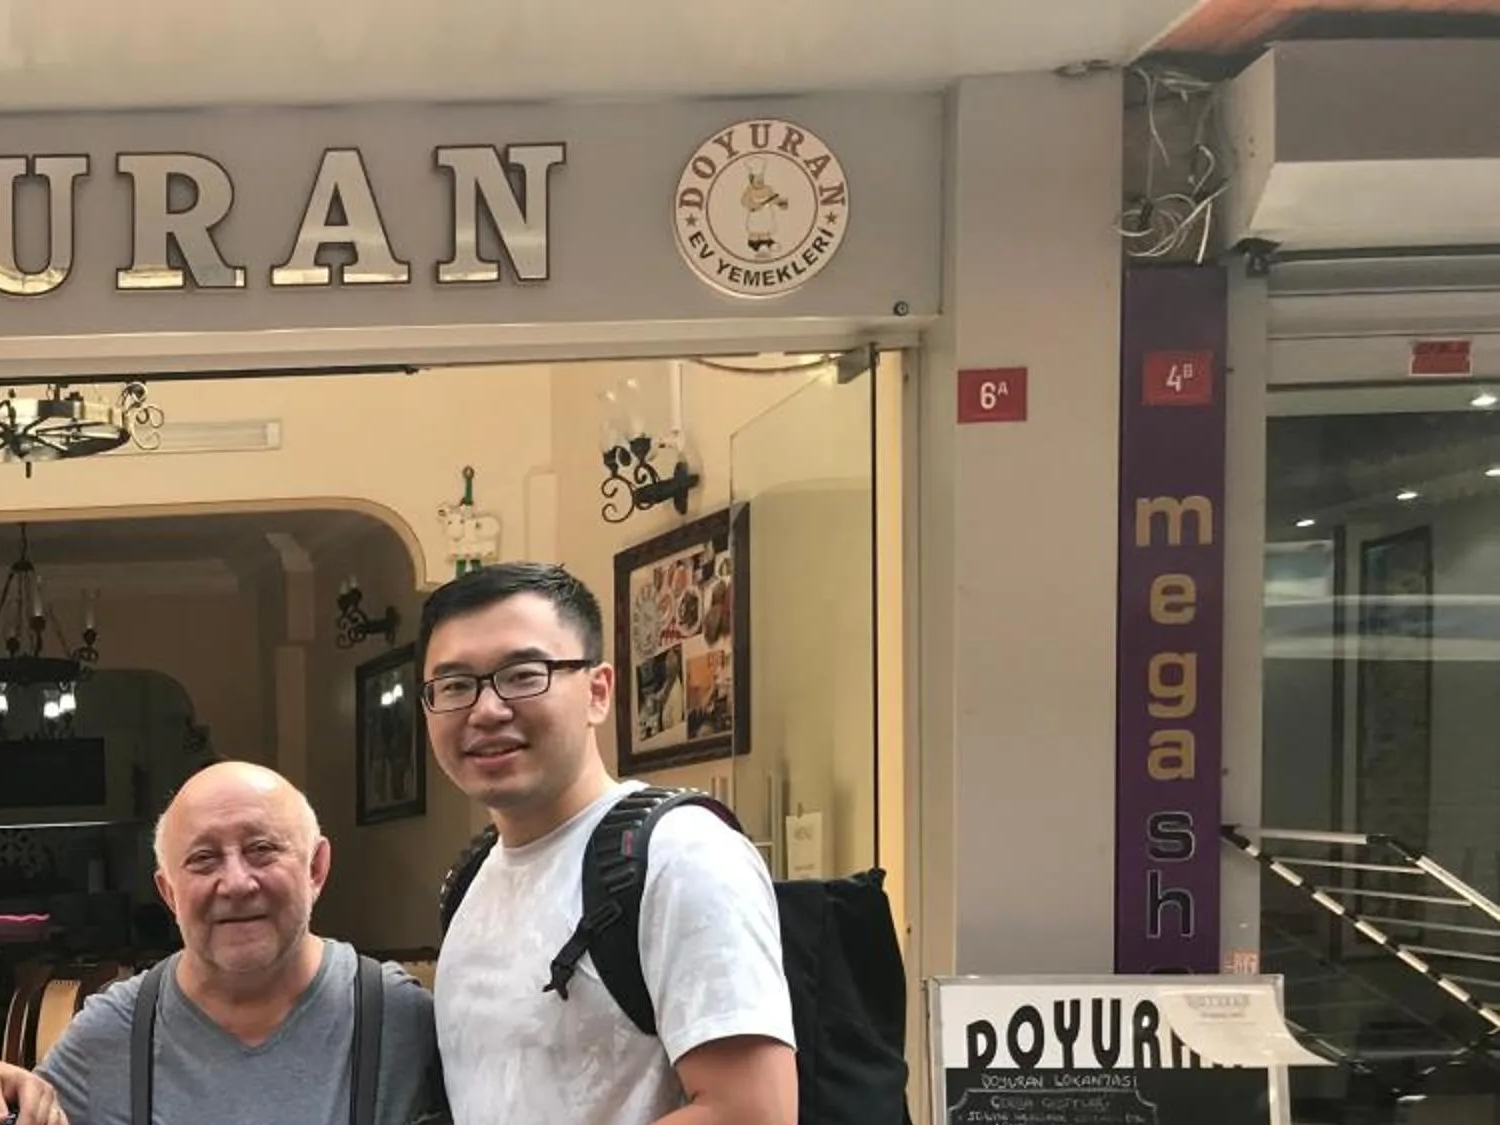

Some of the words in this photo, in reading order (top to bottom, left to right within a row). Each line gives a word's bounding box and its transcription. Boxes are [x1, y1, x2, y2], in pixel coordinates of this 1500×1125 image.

[679, 123, 846, 211] DOYURAN
[689, 231, 715, 260] EV
[716, 227, 835, 287] YEMEKLERİ
[966, 998, 1245, 1068] DOYUR
